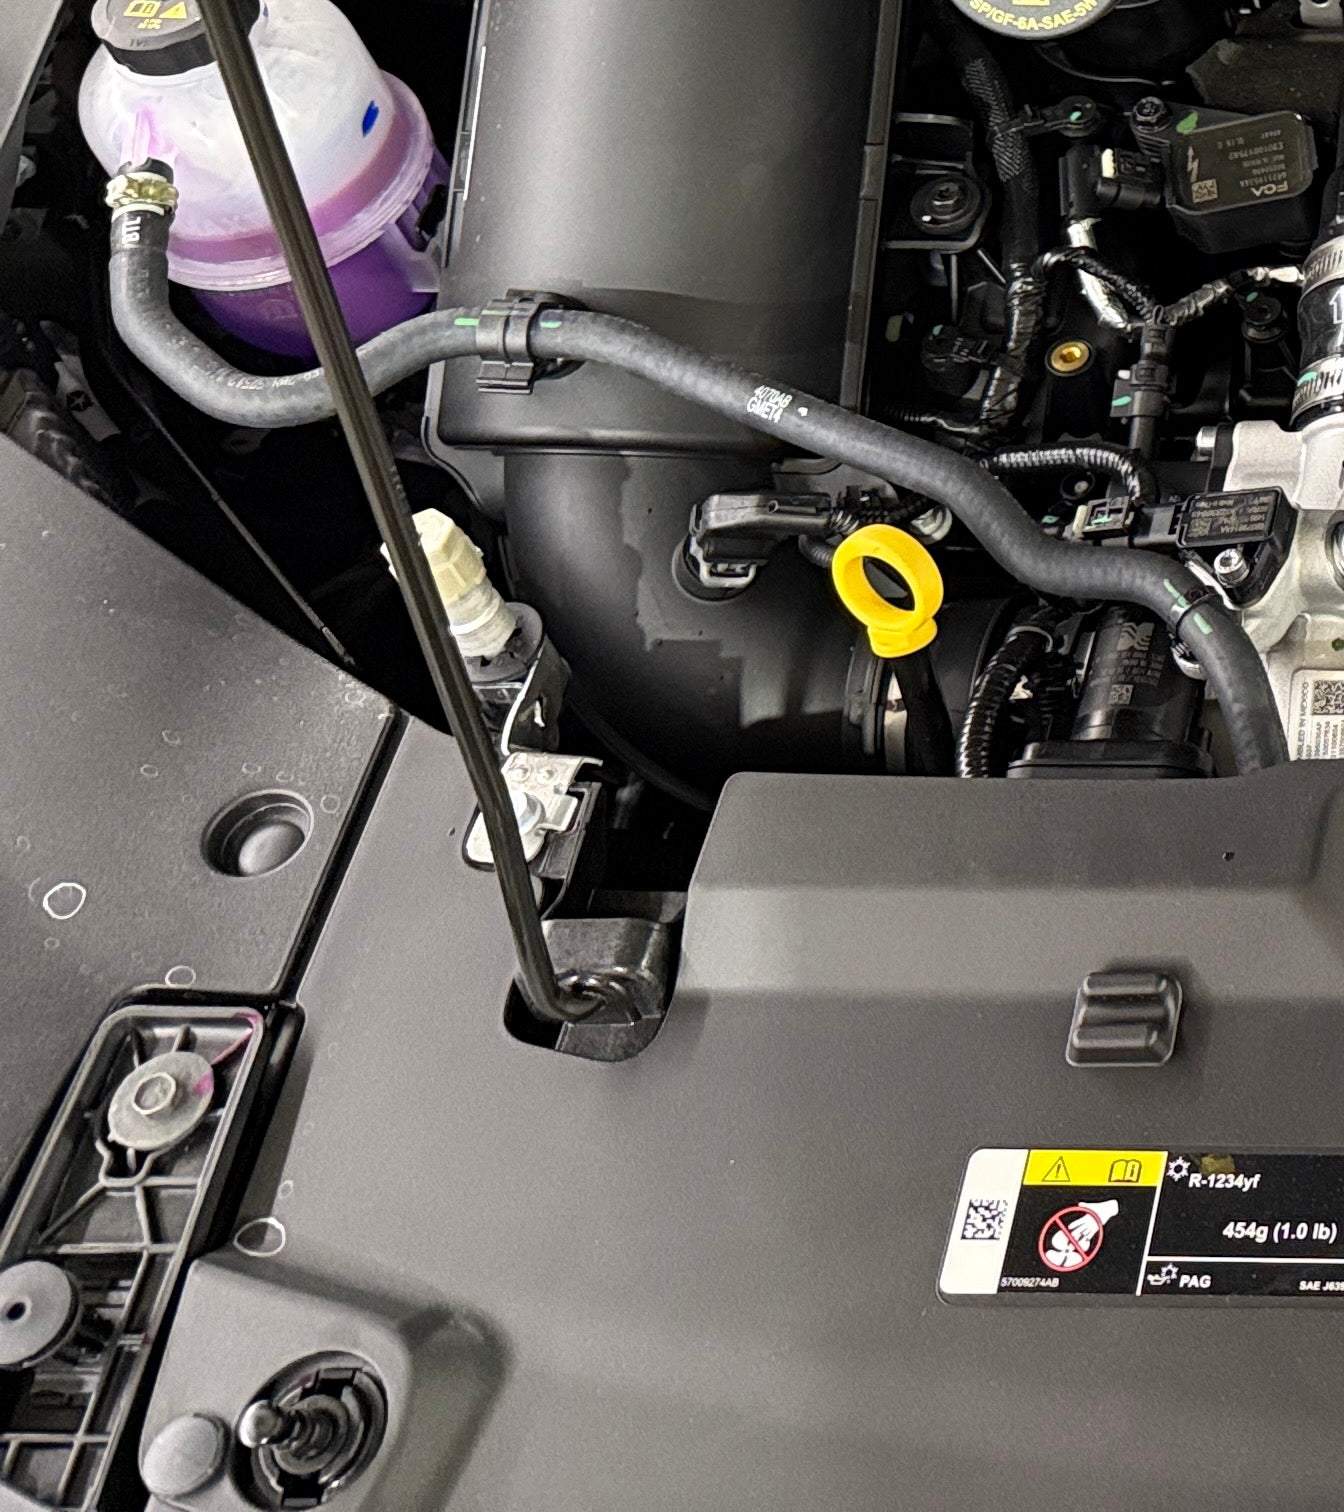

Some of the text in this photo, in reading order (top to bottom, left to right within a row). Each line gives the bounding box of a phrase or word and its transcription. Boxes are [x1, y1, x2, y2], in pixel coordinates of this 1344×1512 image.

[1250, 180, 1288, 197] FCA
[1188, 1173, 1261, 1192] R-1234yf
[1222, 1221, 1338, 1244] 454g (1.0 lb)
[1179, 1274, 1212, 1289] PAG
[1299, 1280, 1320, 1291] SAE
